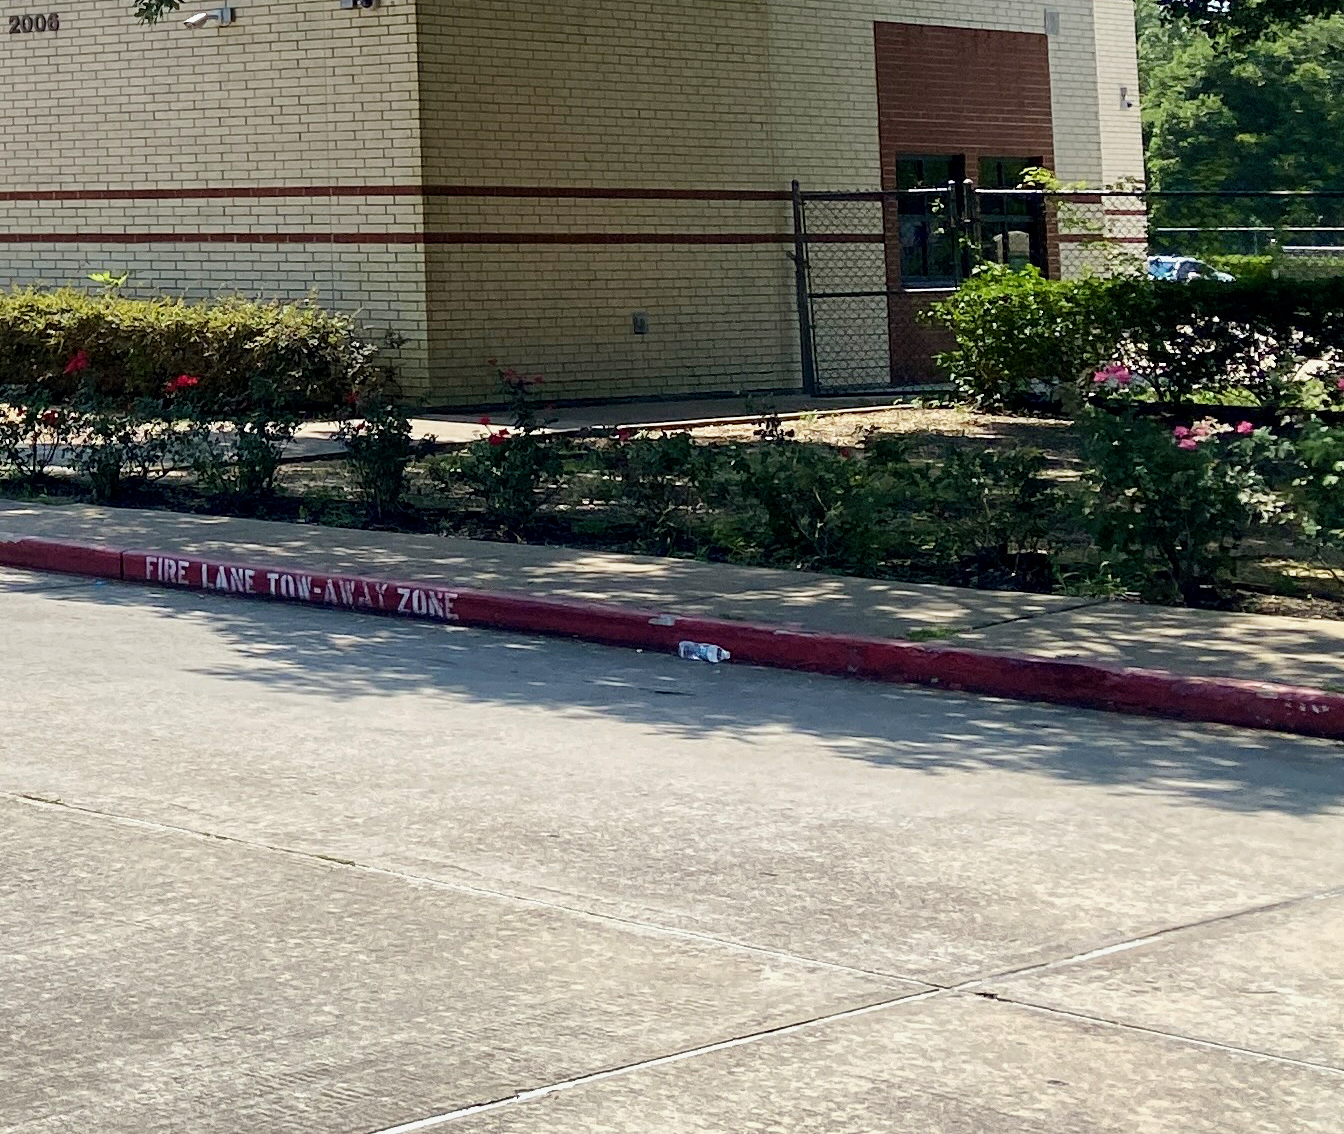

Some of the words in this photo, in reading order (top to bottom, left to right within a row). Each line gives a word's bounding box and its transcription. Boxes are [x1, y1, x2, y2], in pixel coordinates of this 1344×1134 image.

[9, 14, 60, 34] 2006
[146, 556, 190, 584] FIRE
[202, 564, 256, 594] LANE
[267, 573, 388, 609] TOW-AWAY
[397, 588, 459, 620] ZONE
